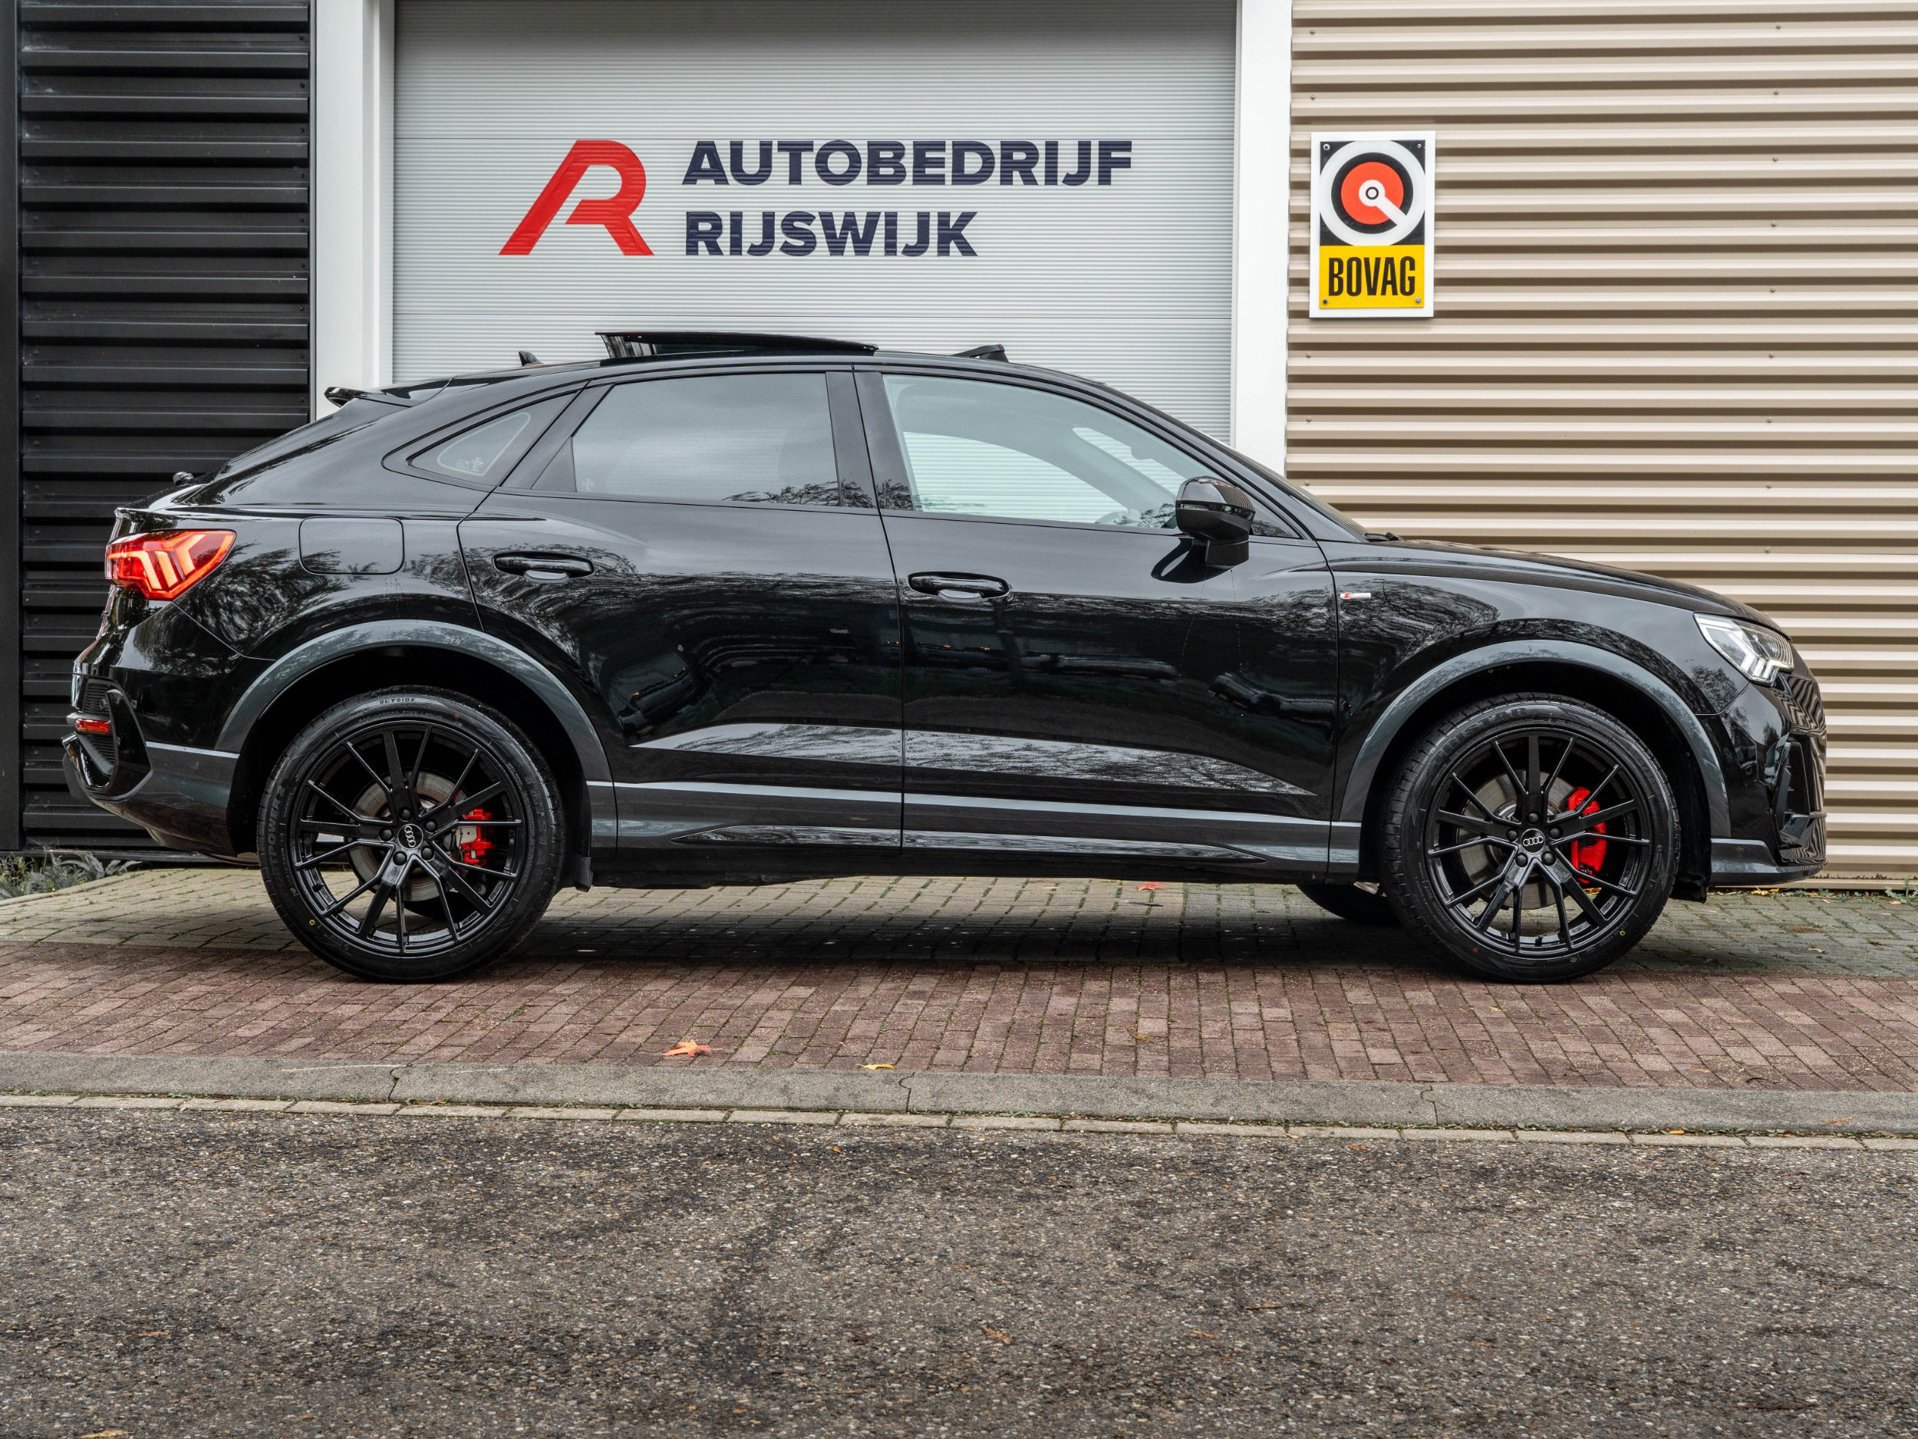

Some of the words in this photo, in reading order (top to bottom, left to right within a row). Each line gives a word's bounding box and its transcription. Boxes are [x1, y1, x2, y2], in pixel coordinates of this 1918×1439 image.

[682, 139, 1132, 187] AUTOBEDRIJF
[685, 211, 978, 257] RIJSWIJK
[1328, 255, 1416, 297] BOVAG
